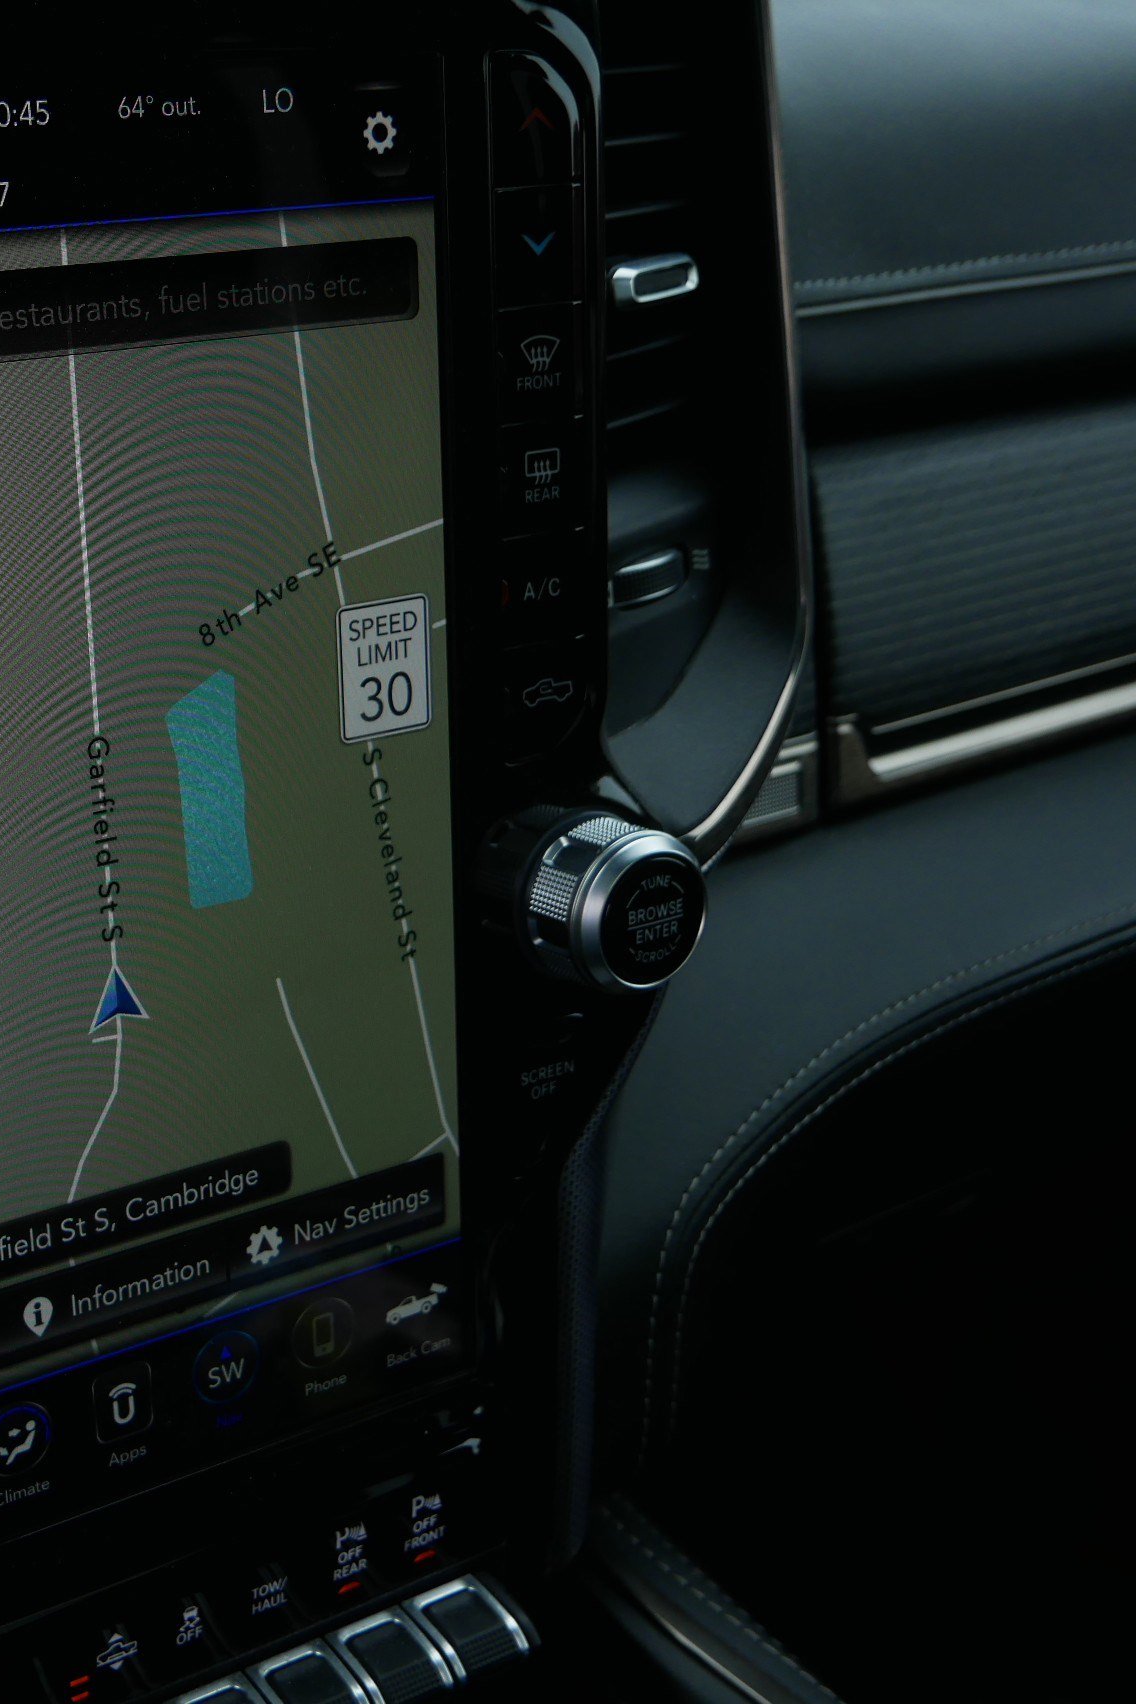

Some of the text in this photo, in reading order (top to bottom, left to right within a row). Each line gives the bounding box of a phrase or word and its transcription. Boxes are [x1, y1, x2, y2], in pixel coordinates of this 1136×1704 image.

[118, 95, 201, 120] 64° out.
[263, 88, 294, 114] LO
[160, 282, 208, 315] fuel
[217, 275, 316, 310] stations
[323, 273, 367, 299] etc.
[517, 372, 562, 392] FRONT
[524, 486, 561, 504] REAR
[198, 542, 341, 647] 8th Ave SE
[523, 576, 562, 601] A/C
[349, 611, 417, 642] SPEED
[357, 638, 412, 667] LIMIT
[360, 671, 413, 722] 30
[87, 736, 123, 943] Garfield St S
[363, 748, 417, 962] S Cleveland St
[640, 873, 672, 893] TUNE
[627, 897, 684, 925] BROWSE
[635, 920, 679, 945] ENTER
[634, 941, 677, 964] SCROLL
[520, 1059, 575, 1087] SCREEN
[531, 1081, 558, 1101] OFF
[61, 1216, 87, 1243] St
[94, 1212, 117, 1236] S,
[125, 1166, 260, 1223] Cambridge
[292, 1187, 431, 1246] Nav Settings
[71, 1256, 210, 1317] Information
[386, 1337, 452, 1368] Back Cam
[208, 1358, 246, 1390] SW
[304, 1372, 348, 1397] Phone
[108, 1444, 149, 1469] Apps
[412, 1513, 441, 1534] OFF
[403, 1524, 447, 1552] FRONT
[337, 1544, 364, 1567] OFF
[333, 1558, 369, 1582] REAR
[251, 1576, 288, 1600] TOW/
[250, 1592, 288, 1616] HAUL
[175, 1627, 205, 1648] OFF
